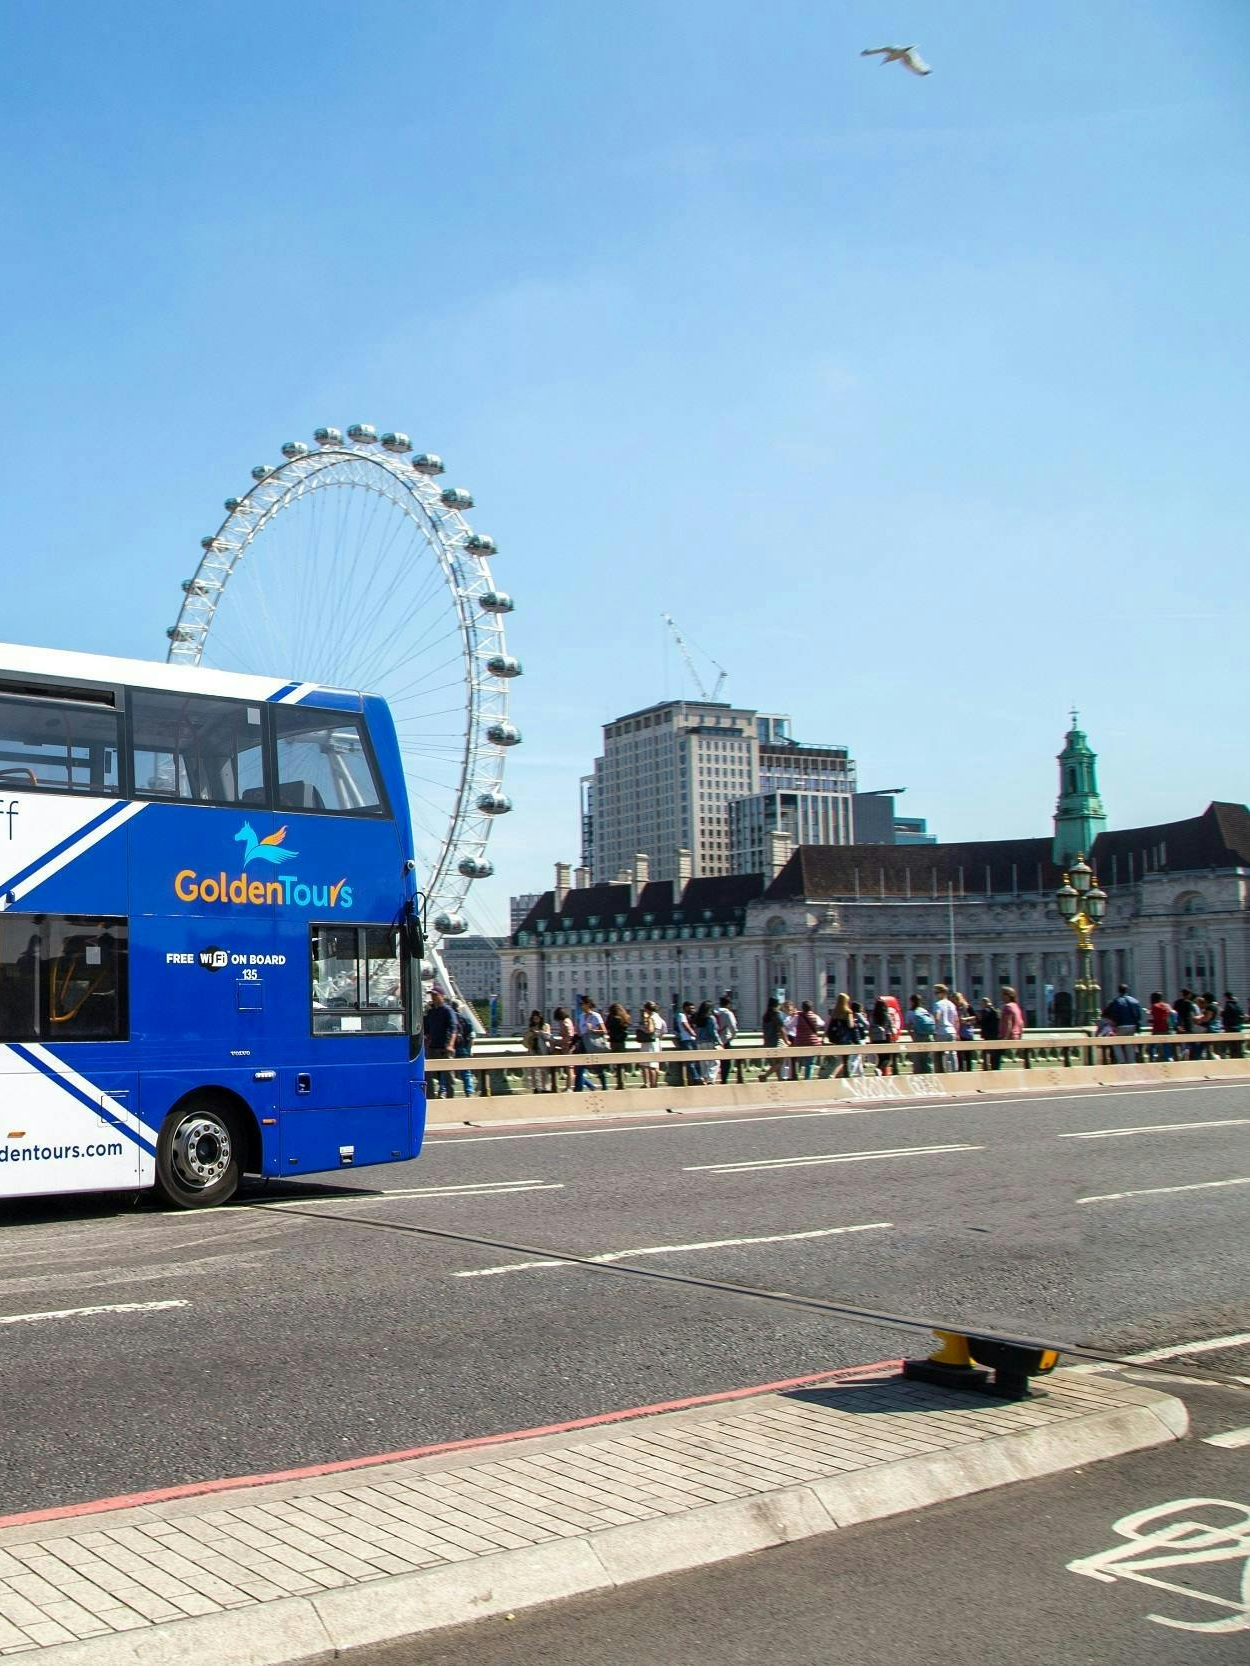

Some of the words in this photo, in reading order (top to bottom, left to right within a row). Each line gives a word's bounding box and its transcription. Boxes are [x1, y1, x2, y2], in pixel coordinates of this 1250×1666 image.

[166, 953, 195, 964] FREE
[231, 954, 247, 965] ON
[249, 955, 286, 965] BOARD
[242, 969, 258, 980] 135
